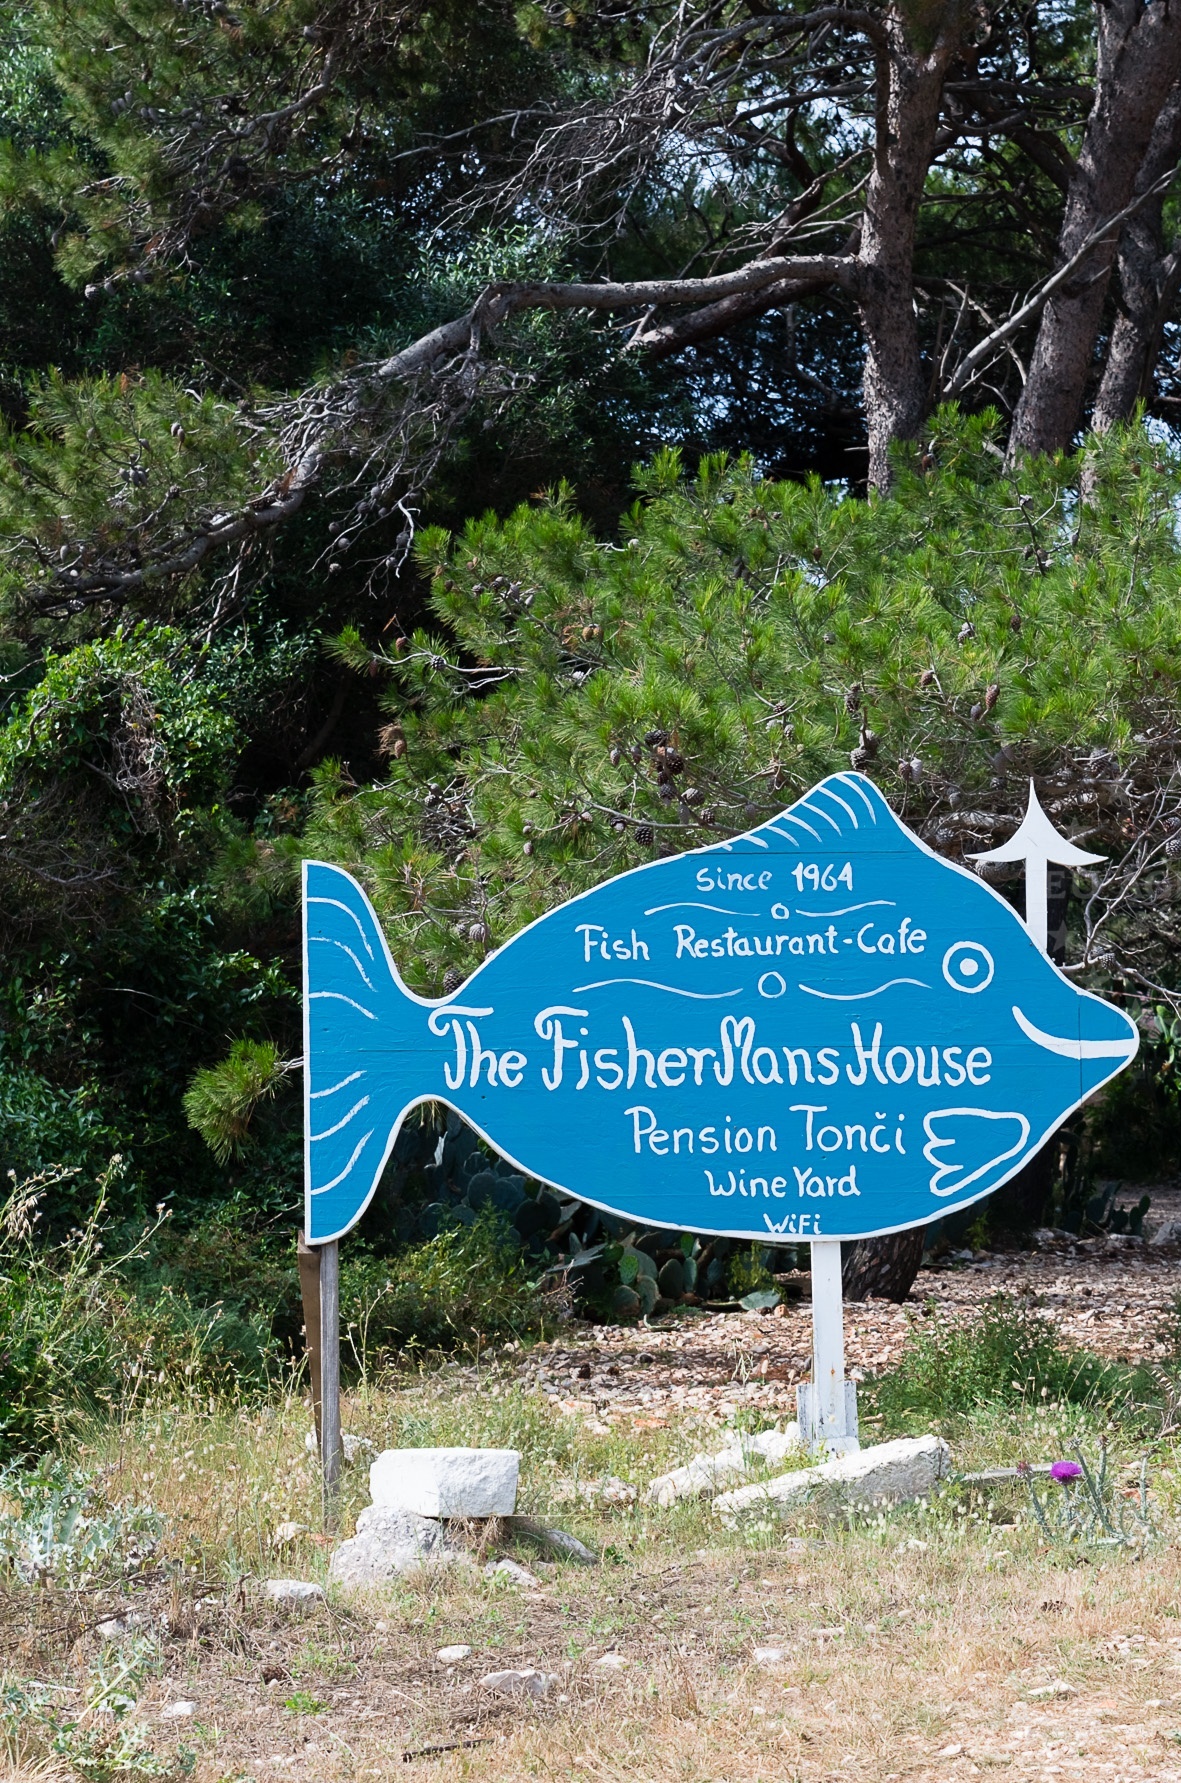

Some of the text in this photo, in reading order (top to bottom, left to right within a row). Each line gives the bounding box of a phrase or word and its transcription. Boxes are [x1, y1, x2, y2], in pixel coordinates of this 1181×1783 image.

[792, 861, 853, 892] 1964
[575, 917, 927, 962] Fish Restaurant-Cafe
[428, 1006, 528, 1090] The
[624, 1104, 906, 1156] Pension Tonči
[763, 1213, 822, 1235] WiFi
